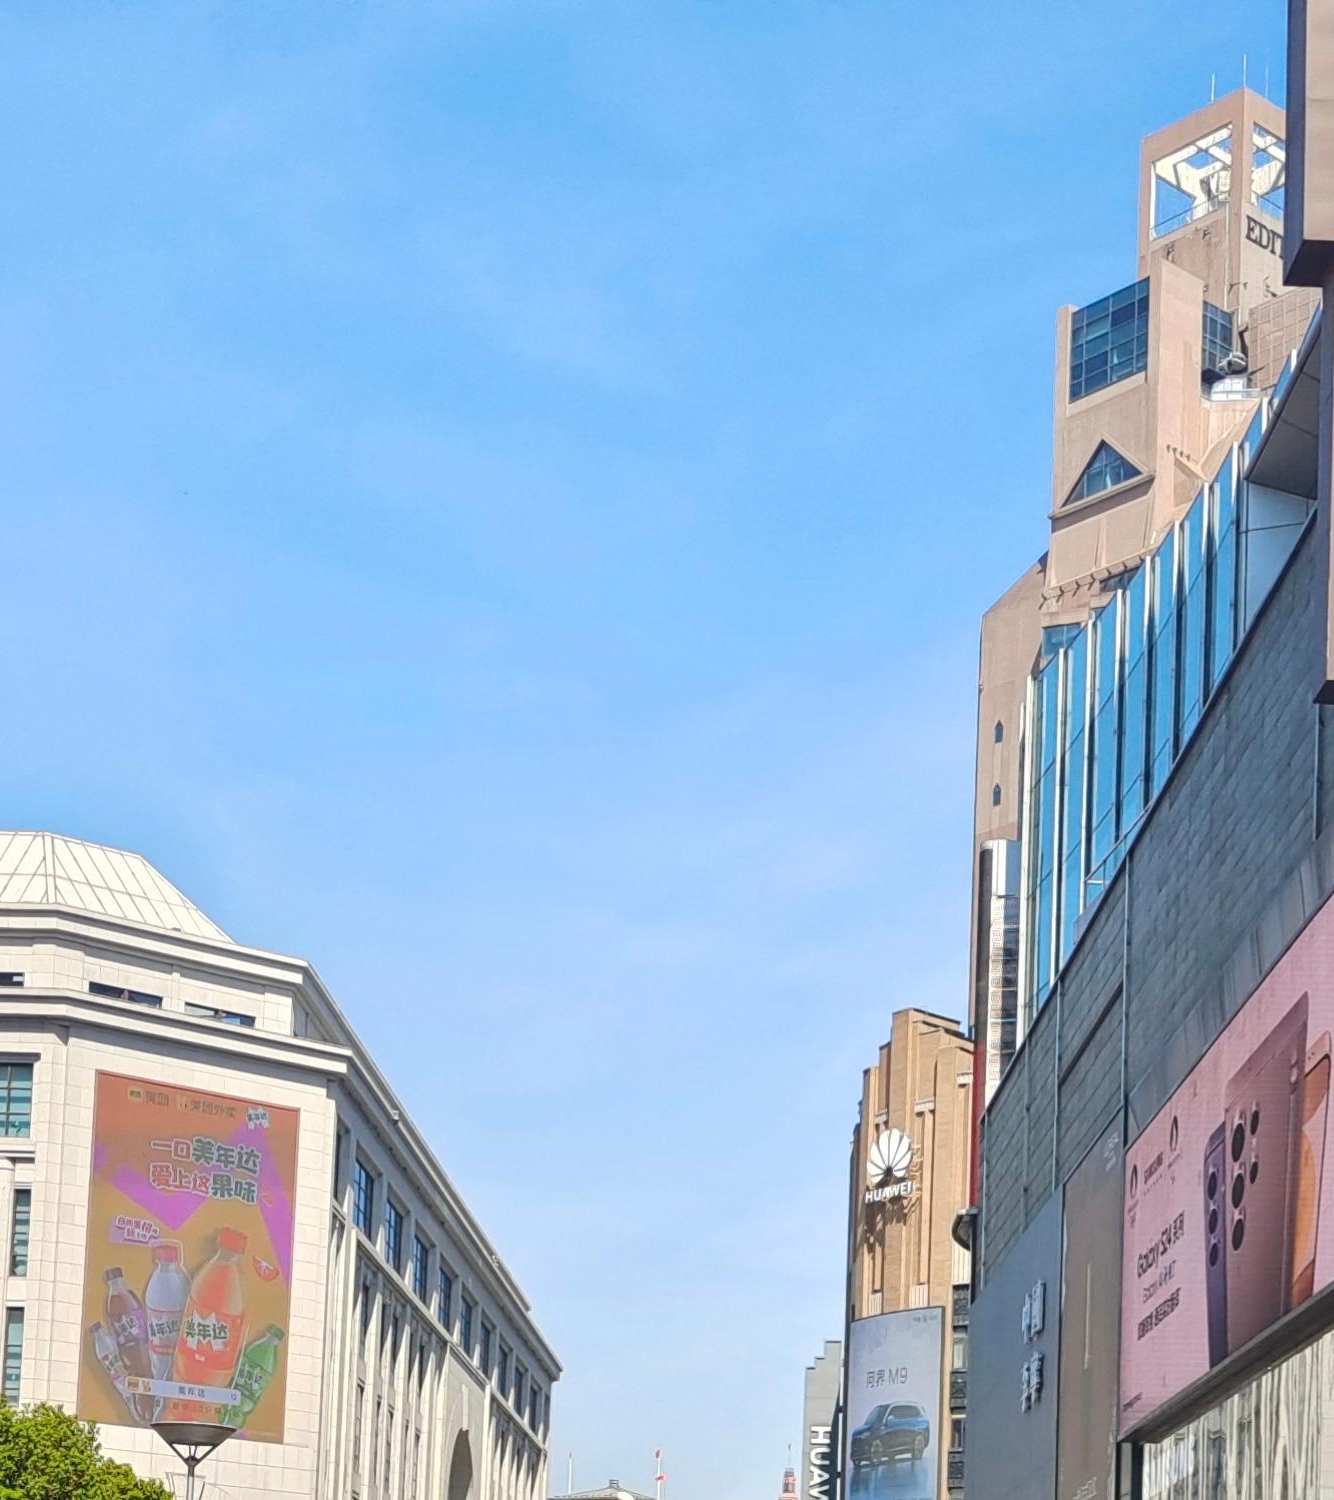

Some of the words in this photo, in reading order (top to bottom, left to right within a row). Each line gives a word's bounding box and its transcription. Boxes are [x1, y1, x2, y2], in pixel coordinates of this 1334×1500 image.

[151, 1136, 261, 1176] 一口美年达
[150, 1162, 258, 1205] 爱上这果味
[864, 1180, 913, 1204] HUAWEI
[185, 1317, 228, 1341] 美年达
[889, 1367, 908, 1385] M9
